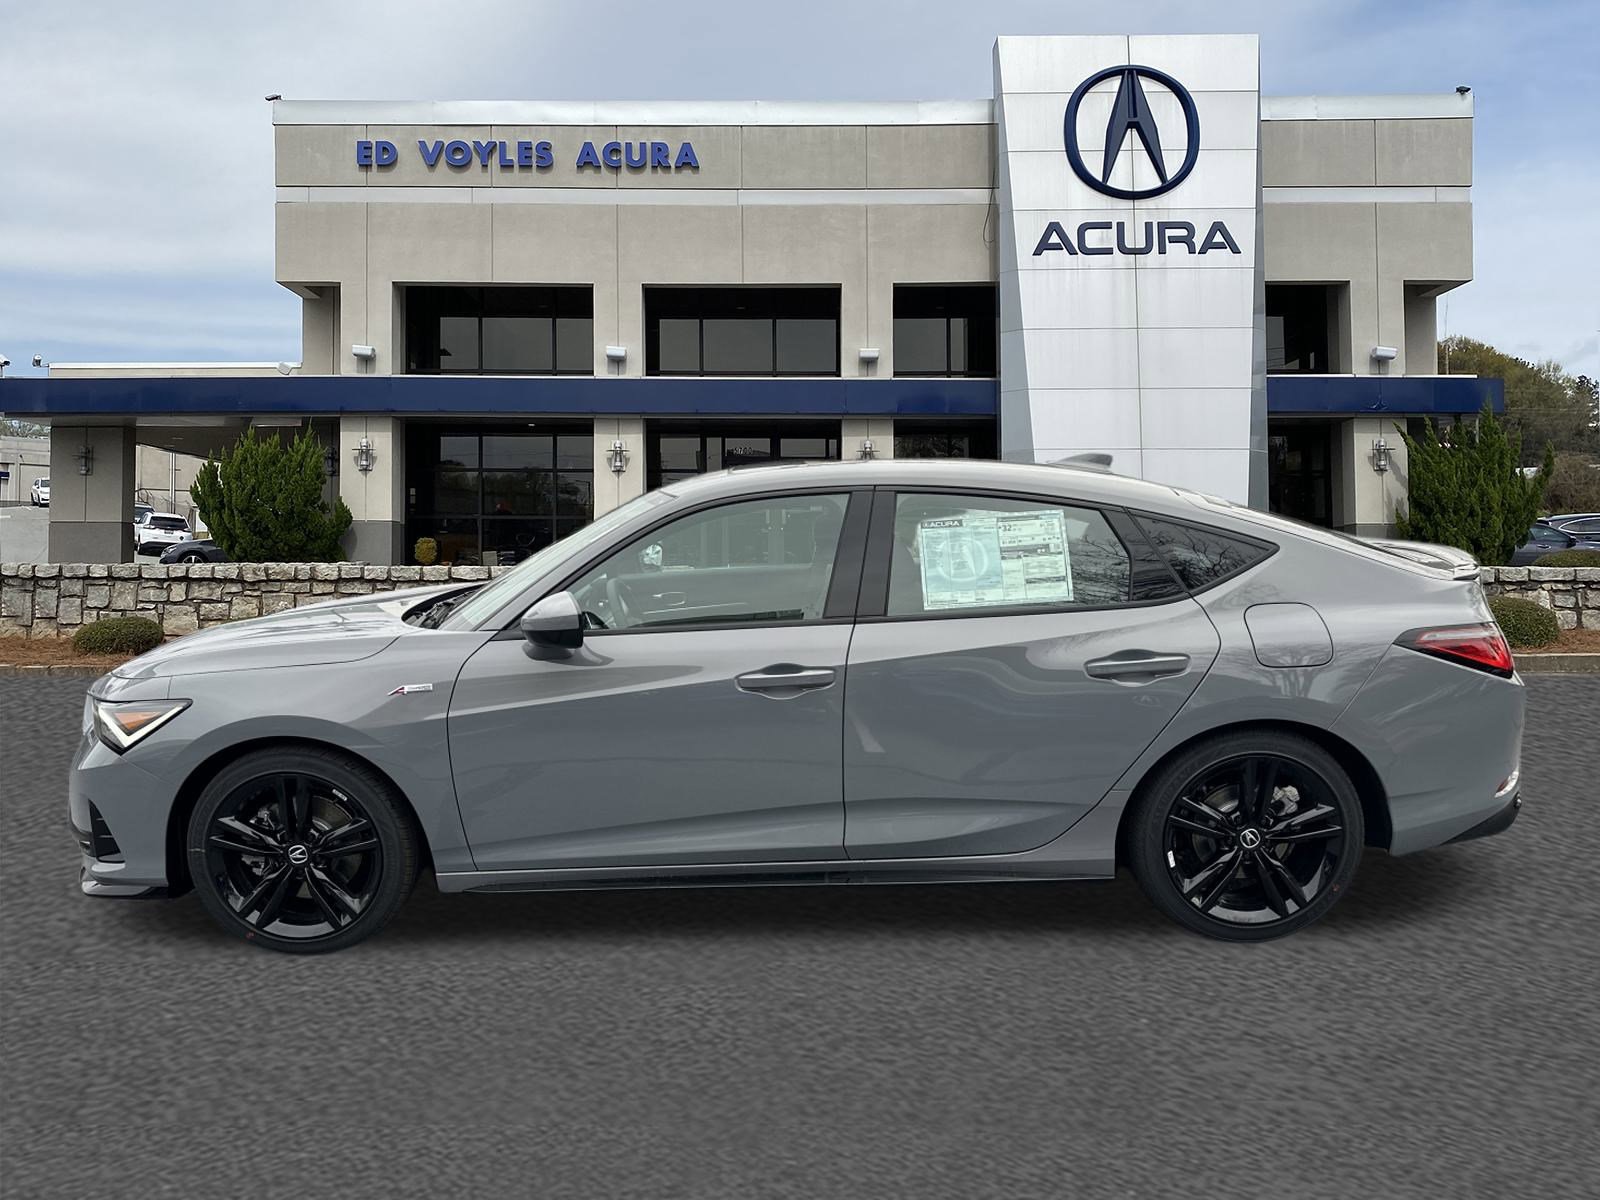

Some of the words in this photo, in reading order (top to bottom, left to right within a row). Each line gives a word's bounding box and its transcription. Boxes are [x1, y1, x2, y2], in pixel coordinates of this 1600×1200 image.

[356, 140, 398, 167] ED
[418, 140, 553, 168] VOYLES
[576, 141, 700, 168] ACURA
[1033, 221, 1242, 255] ACURA
[929, 520, 960, 528] ACURA
